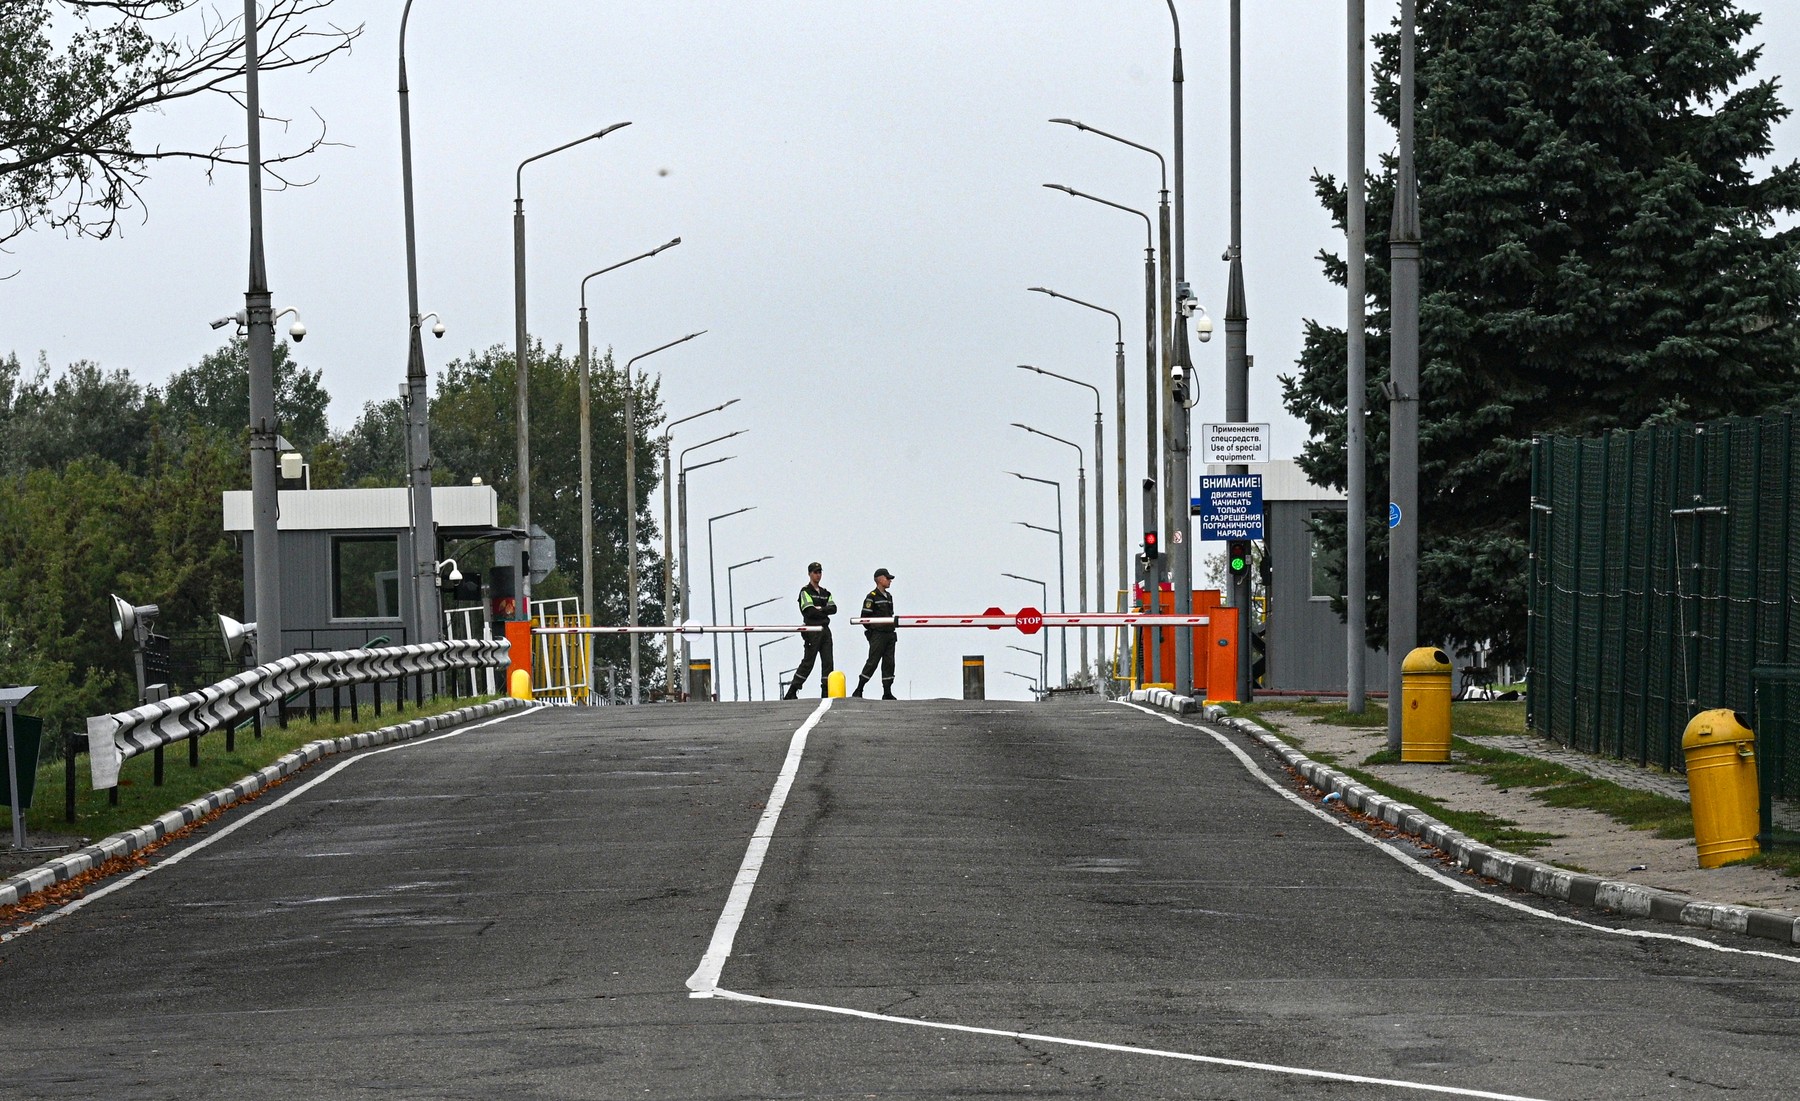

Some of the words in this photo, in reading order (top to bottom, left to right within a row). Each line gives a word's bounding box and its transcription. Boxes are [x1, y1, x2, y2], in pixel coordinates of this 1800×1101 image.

[1212, 425, 1260, 434] Применение
[1210, 444, 1225, 452] Use
[1235, 444, 1262, 453] special
[1215, 453, 1256, 462] equipment.
[1202, 477, 1261, 489] ВНИМАНИЕ!
[1211, 491, 1252, 500] ДВИЖЕНИЕ
[1217, 506, 1247, 514] ТОЛЬКО
[1210, 514, 1261, 522] РАЗРЕШЕНИЯ
[1202, 522, 1262, 530] ПОГРАНИЧНОГО
[1017, 617, 1040, 625] STOP
